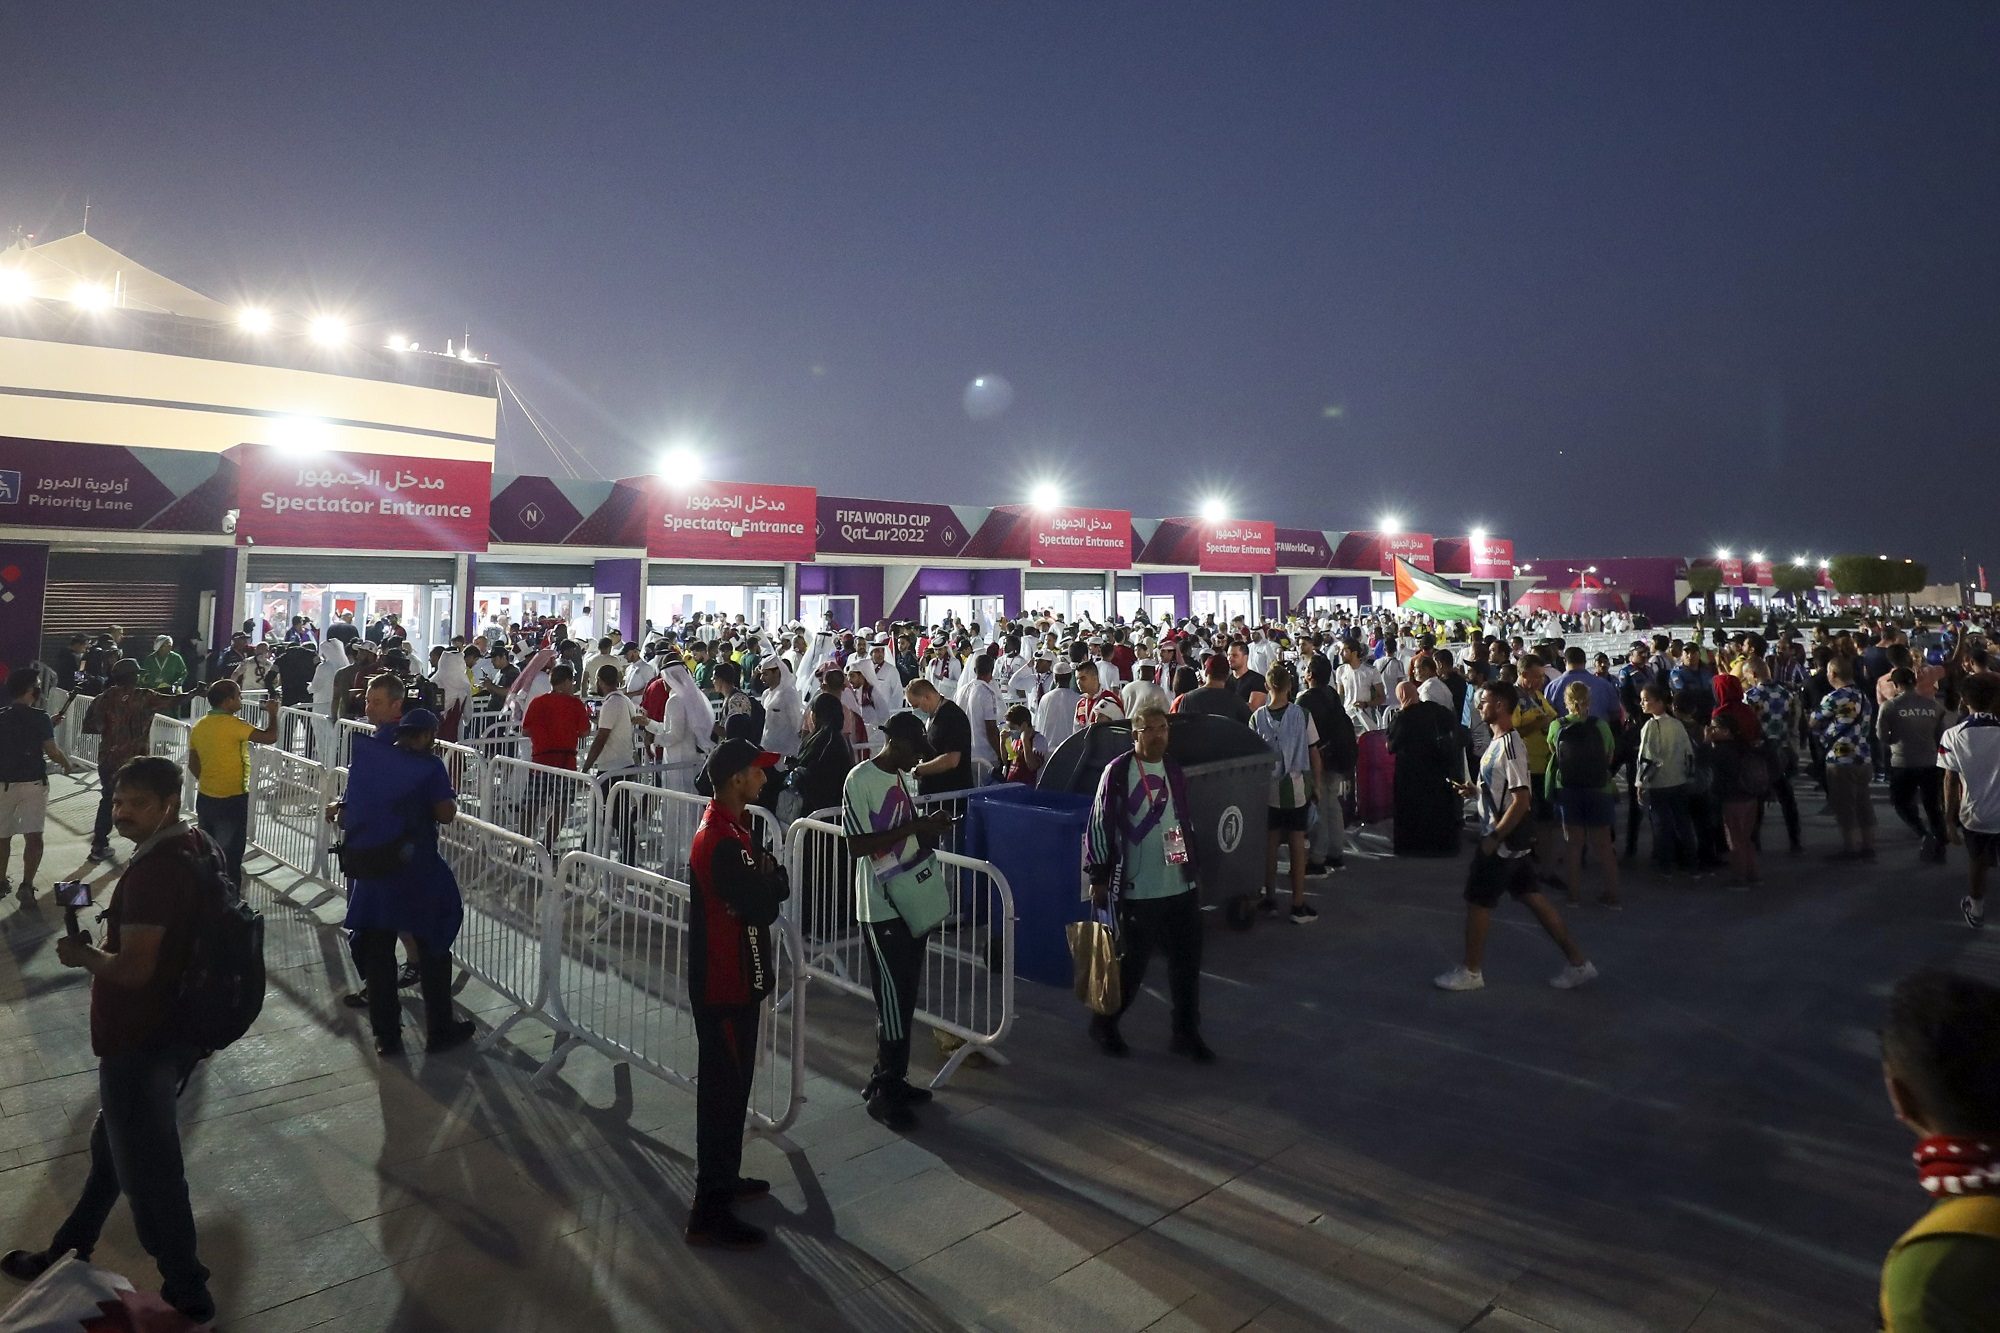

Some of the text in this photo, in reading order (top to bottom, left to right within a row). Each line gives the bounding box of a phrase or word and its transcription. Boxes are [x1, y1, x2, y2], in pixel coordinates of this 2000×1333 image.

[37, 476, 129, 494] أولوية المرور
[296, 468, 445, 492] مدخل الجمهور
[28, 494, 133, 512] Priority Lane
[261, 491, 472, 518] Spectator Entrance
[686, 495, 785, 513] مدخل الجمهور
[526, 510, 537, 522] N
[663, 513, 804, 534] Spectator Entrance
[836, 509, 931, 527] FIFA WORLD CUP
[1051, 517, 1112, 532] مدخل الجمهور
[945, 531, 952, 541] N
[1039, 533, 1124, 548] Spectator Entrance
[1216, 528, 1262, 541] مدخل الجمهور
[1206, 542, 1271, 555] Spectator Entrance
[1275, 542, 1315, 555] FAWorldCup
[1899, 708, 1937, 718] QATAR
[747, 925, 764, 990] Security
